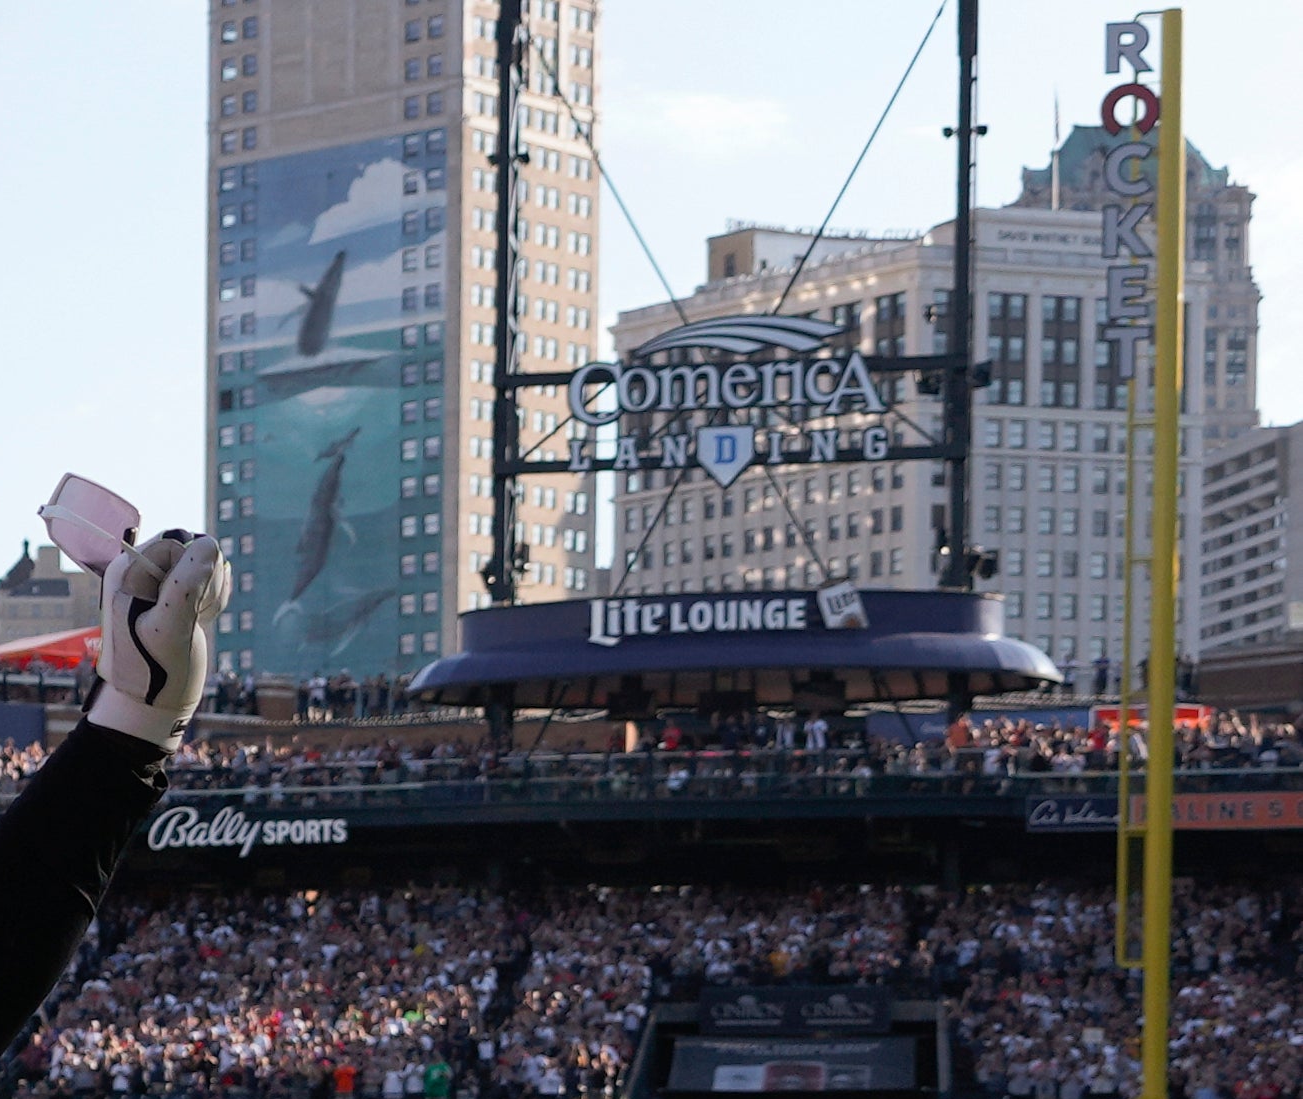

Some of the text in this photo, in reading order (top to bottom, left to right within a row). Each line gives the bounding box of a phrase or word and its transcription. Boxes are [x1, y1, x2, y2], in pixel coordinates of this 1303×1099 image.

[588, 600, 807, 646] Lite LOUNGE
[148, 805, 348, 859] Bally SPORTS
